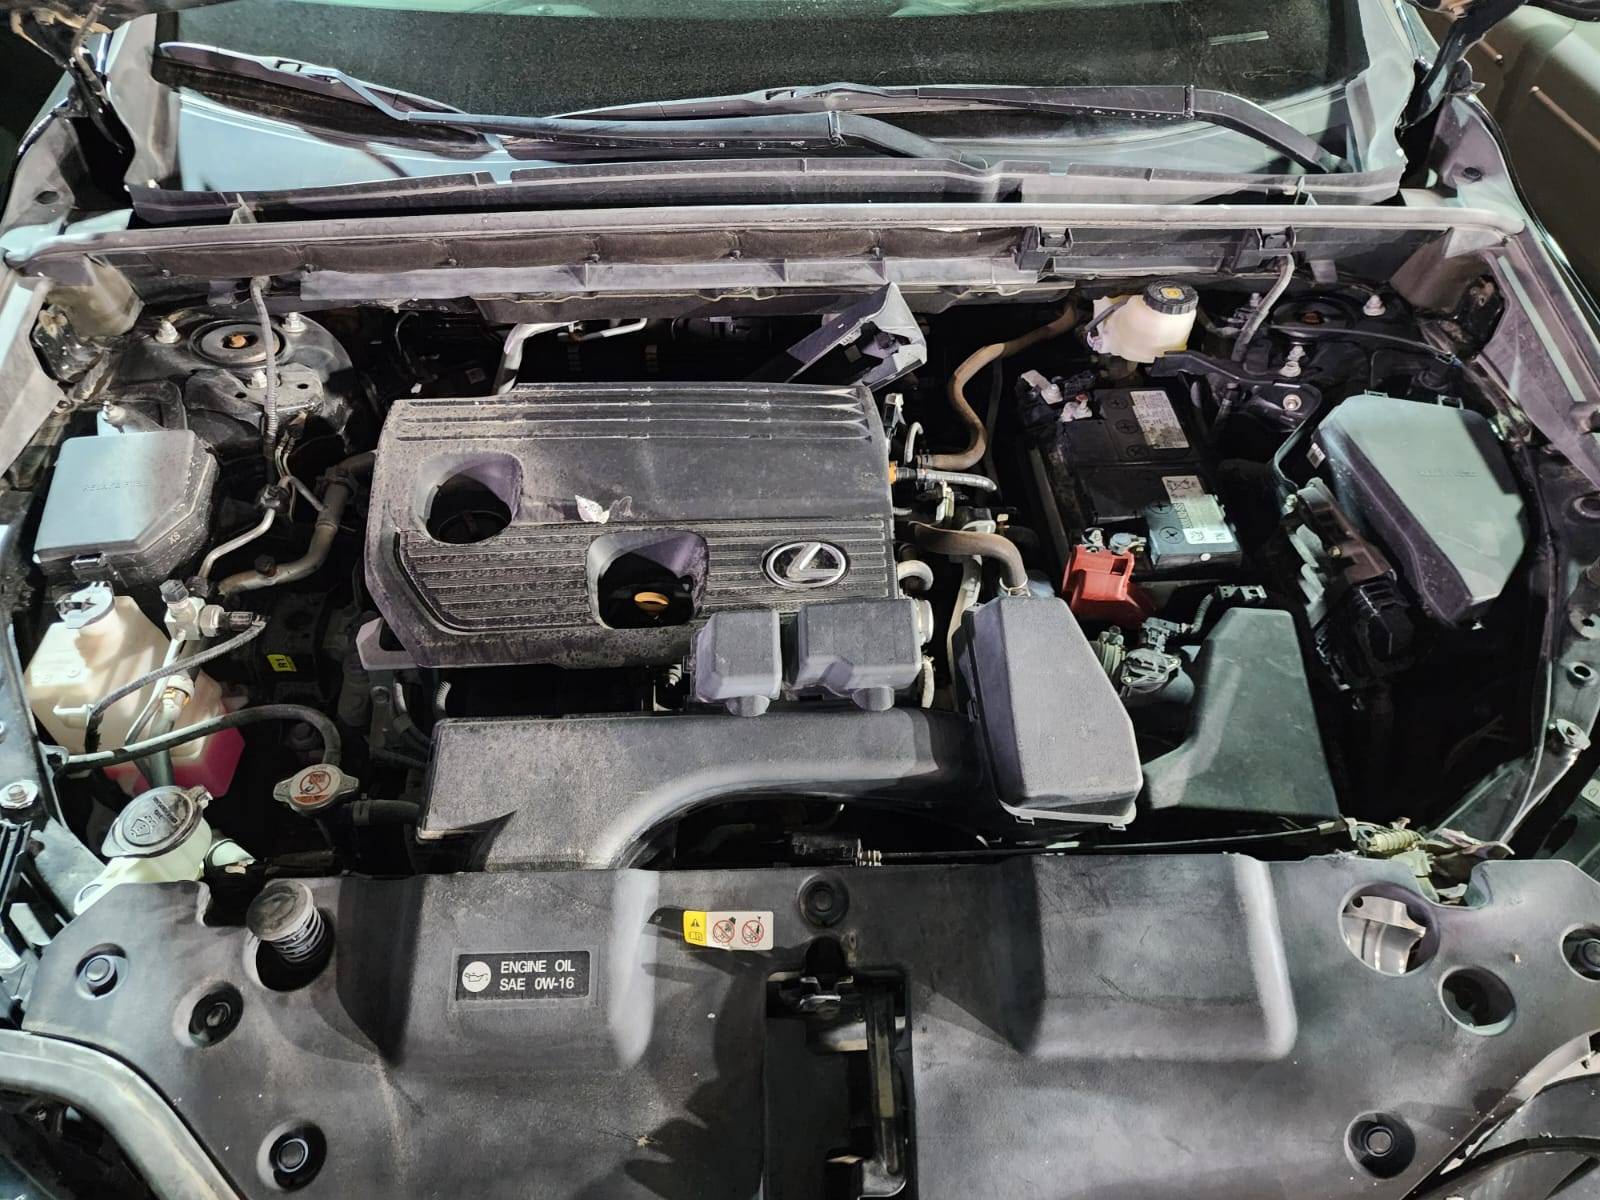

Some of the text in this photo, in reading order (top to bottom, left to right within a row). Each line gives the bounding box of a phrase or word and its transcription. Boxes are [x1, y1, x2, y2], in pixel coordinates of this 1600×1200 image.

[500, 959, 576, 974] ENGINE OIL
[499, 977, 575, 991] SAE 0W-16
